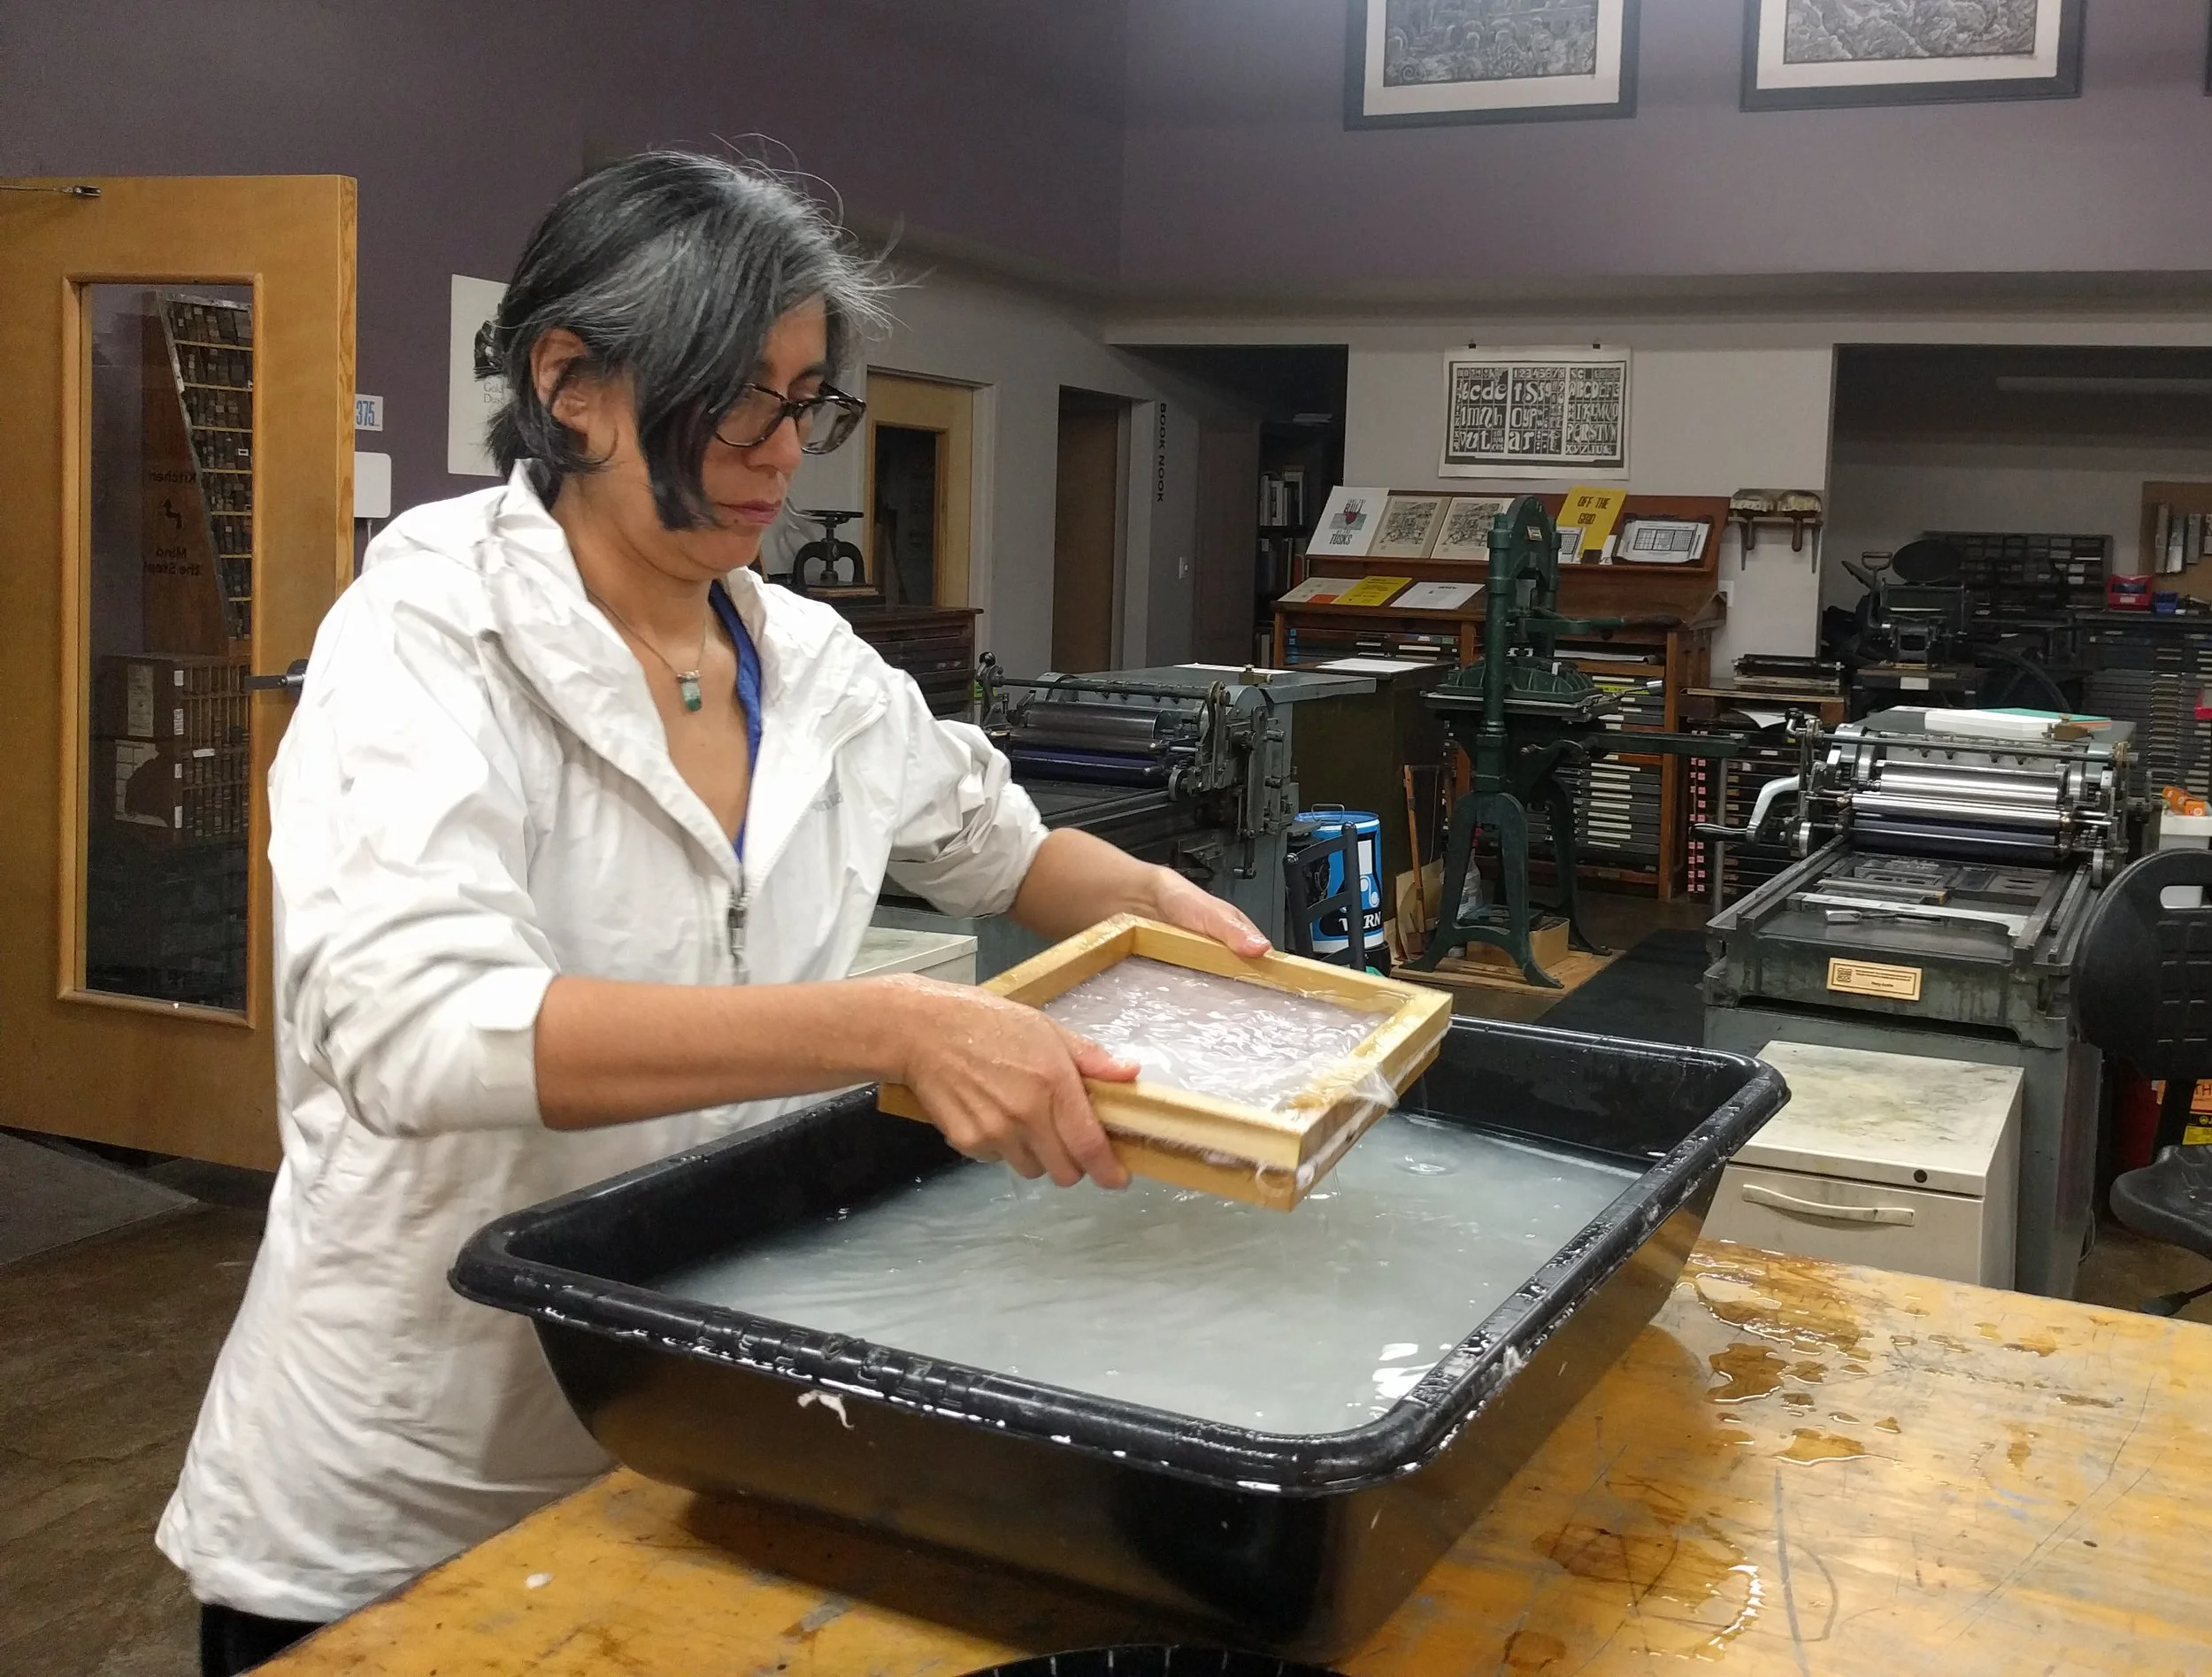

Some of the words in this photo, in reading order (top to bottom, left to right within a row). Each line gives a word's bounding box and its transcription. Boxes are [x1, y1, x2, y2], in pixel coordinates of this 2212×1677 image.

[356, 400, 374, 427] 375
[1577, 496, 1594, 508] OFF
[1595, 497, 1611, 509] THE
